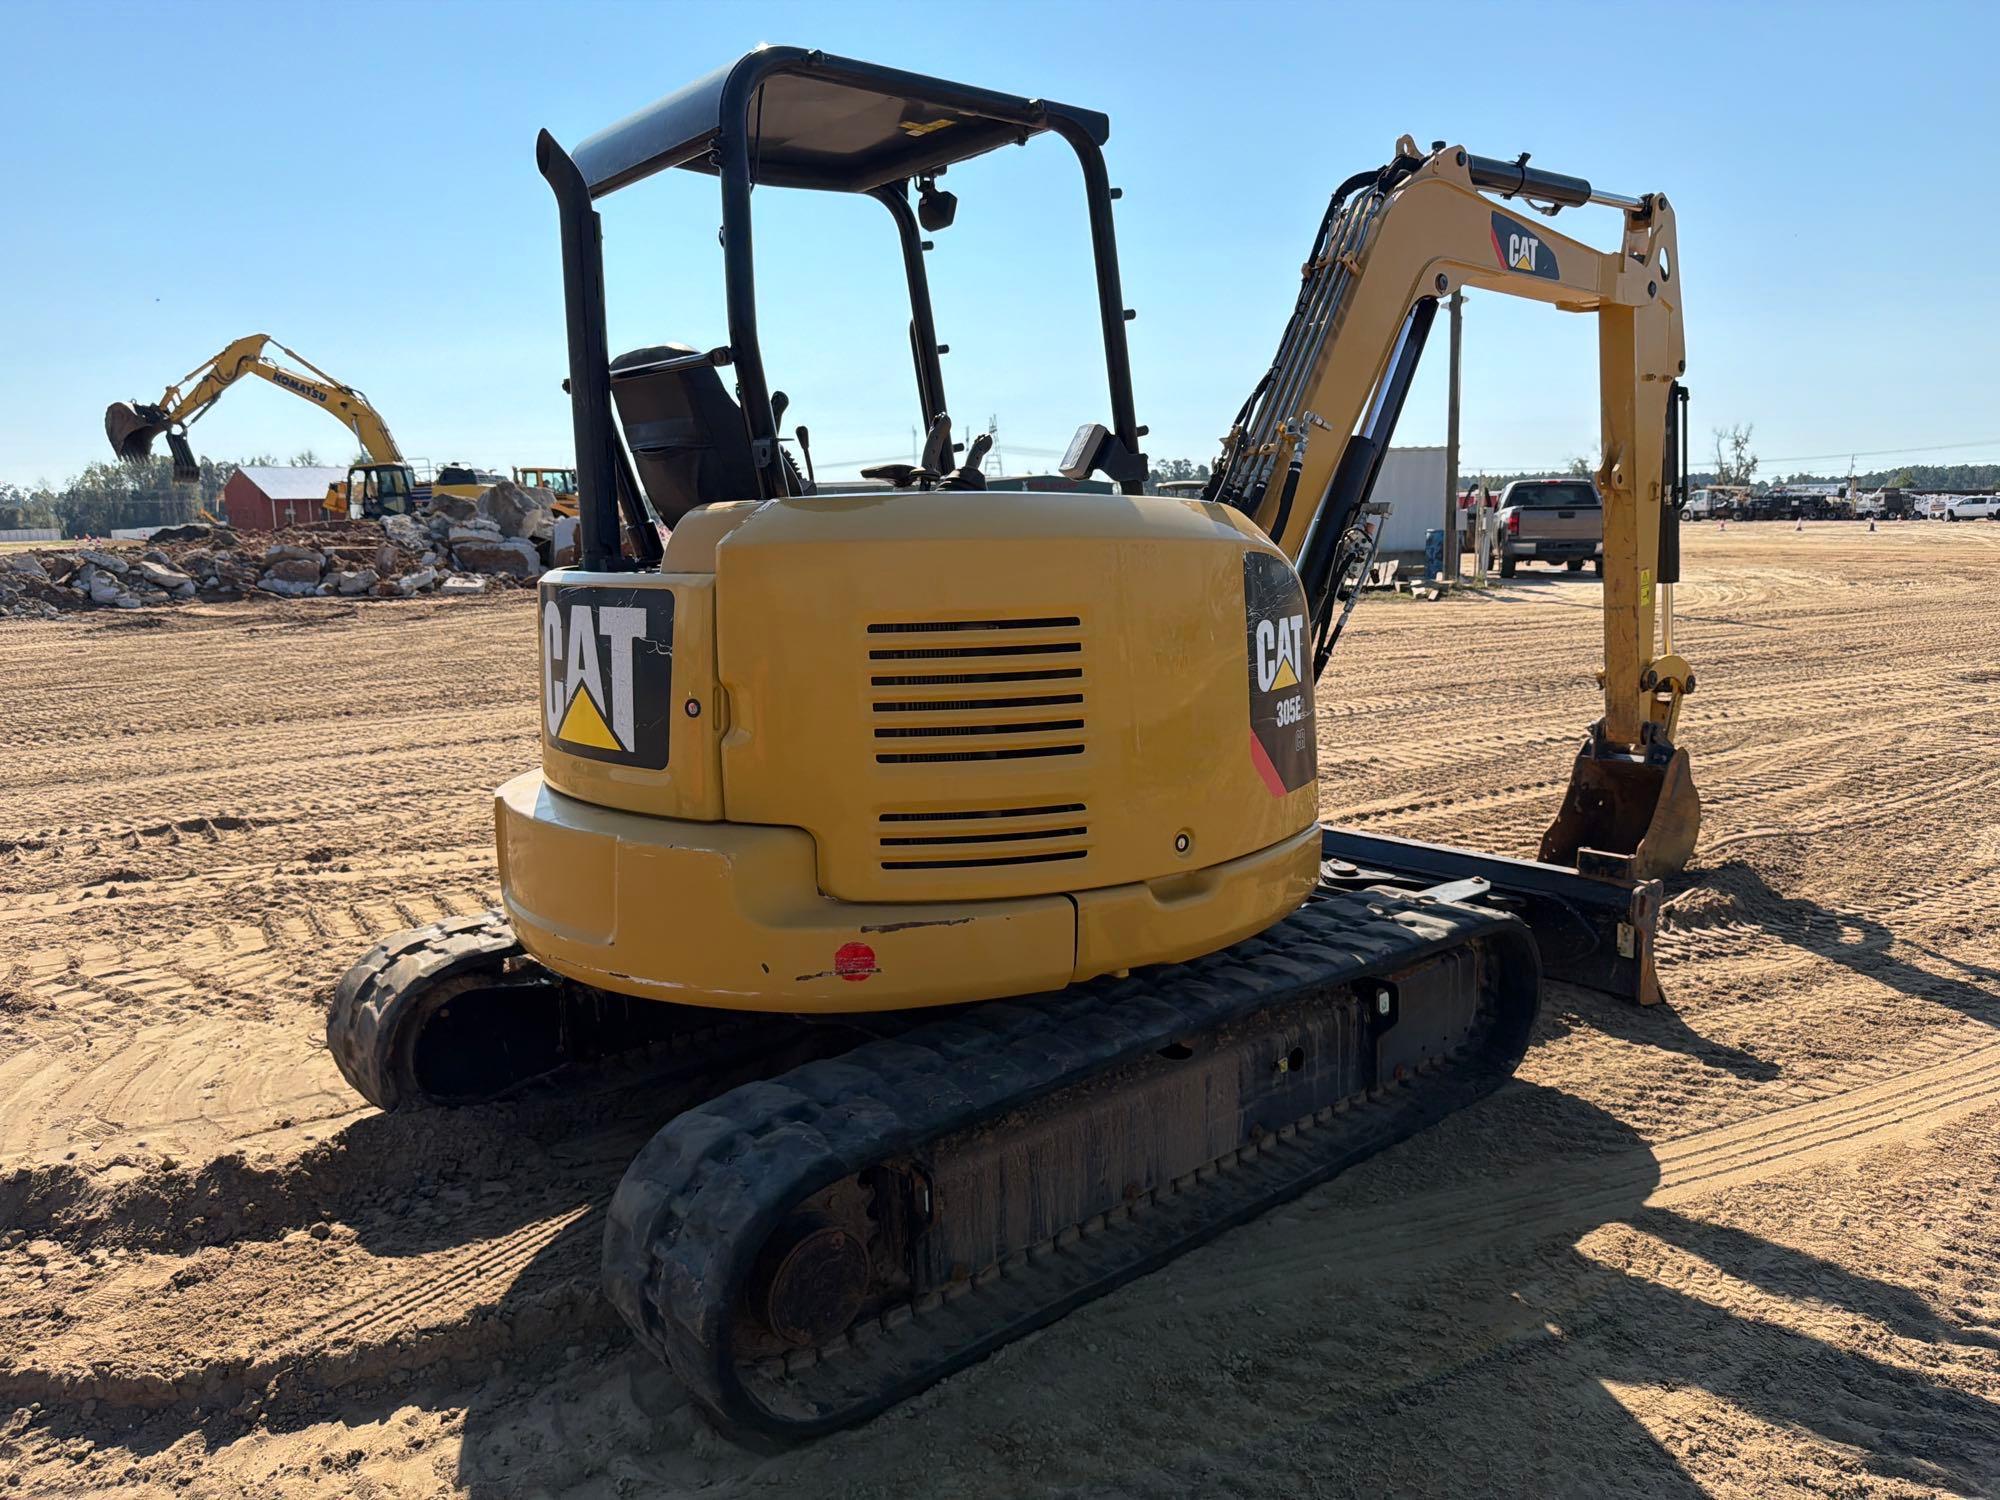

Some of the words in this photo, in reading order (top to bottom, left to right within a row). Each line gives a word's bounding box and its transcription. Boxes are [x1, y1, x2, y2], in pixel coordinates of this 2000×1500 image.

[1508, 233, 1538, 271] CAT
[273, 372, 327, 402] KOMATSU
[544, 600, 647, 753] CAT
[1256, 614, 1304, 693] CAT
